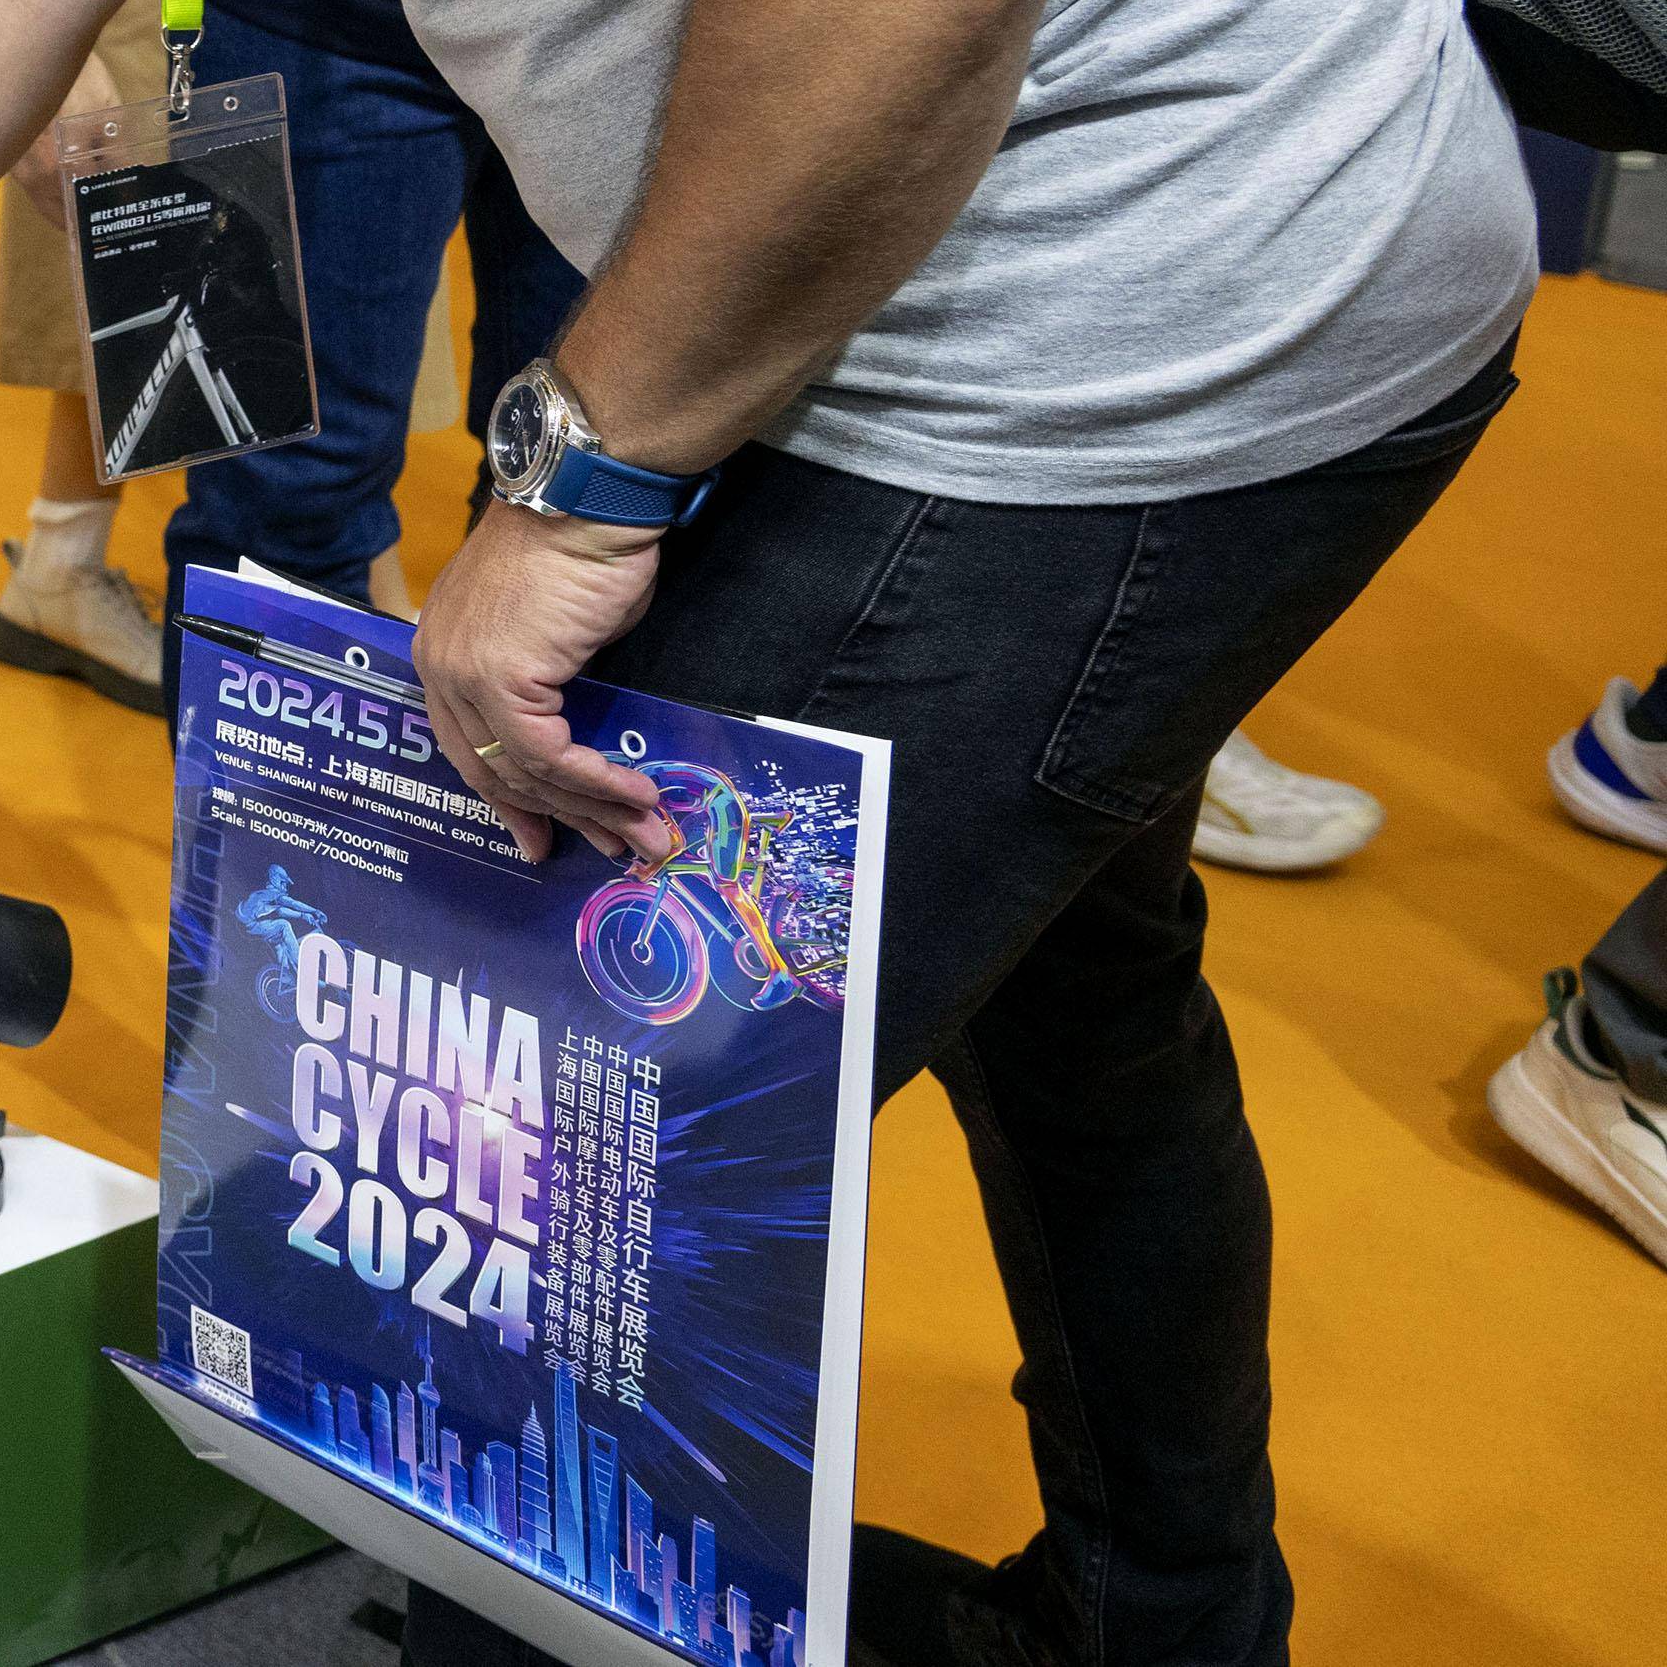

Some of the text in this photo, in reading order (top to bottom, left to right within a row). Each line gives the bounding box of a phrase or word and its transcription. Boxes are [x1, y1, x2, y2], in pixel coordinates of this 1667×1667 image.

[211, 805, 245, 828] Scale:
[214, 750, 254, 774] VENUE:
[257, 765, 317, 792] SHANGHAI
[320, 784, 349, 804] NEW
[352, 796, 446, 835] INTERNATIONAL
[451, 827, 484, 848] EXPO
[242, 797, 410, 865] 150000平方米/7000个展位
[295, 931, 545, 1131] CHINA
[292, 1042, 542, 1246] CYCLE
[543, 1025, 579, 1373] 上海国际户外骑行装备展览会
[567, 1034, 603, 1386] 中国国际摩托车及零部件展览会
[591, 1043, 629, 1398] 中国国际电动车及零配件展览会
[616, 1055, 662, 1412] 中国国际自行车展览会
[288, 1151, 536, 1357] 2024
